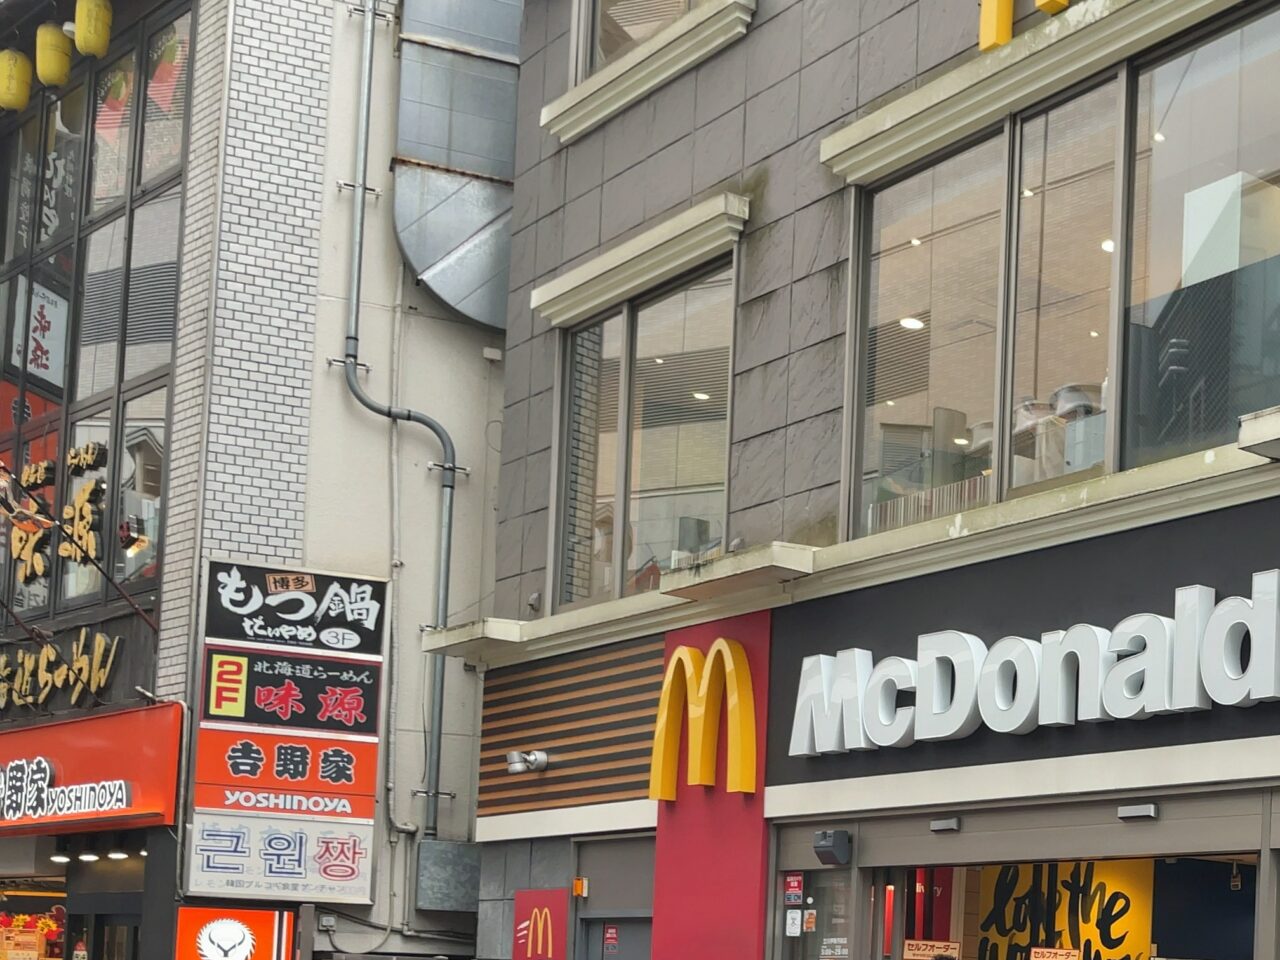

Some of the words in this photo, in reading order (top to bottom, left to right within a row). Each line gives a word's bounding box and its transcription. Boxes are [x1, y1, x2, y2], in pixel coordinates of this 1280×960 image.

[272, 576, 310, 590] 博多
[217, 566, 381, 631] もつ鍋
[326, 631, 354, 646] 3F
[253, 661, 373, 684] 北海道らーめん
[0, 756, 50, 820] 野家
[48, 780, 127, 815] YOSHINOYA
[224, 791, 352, 814] YOSHINOYA
[907, 943, 957, 952] セルフオーダー
[1033, 951, 1077, 960] セルフオーダー
